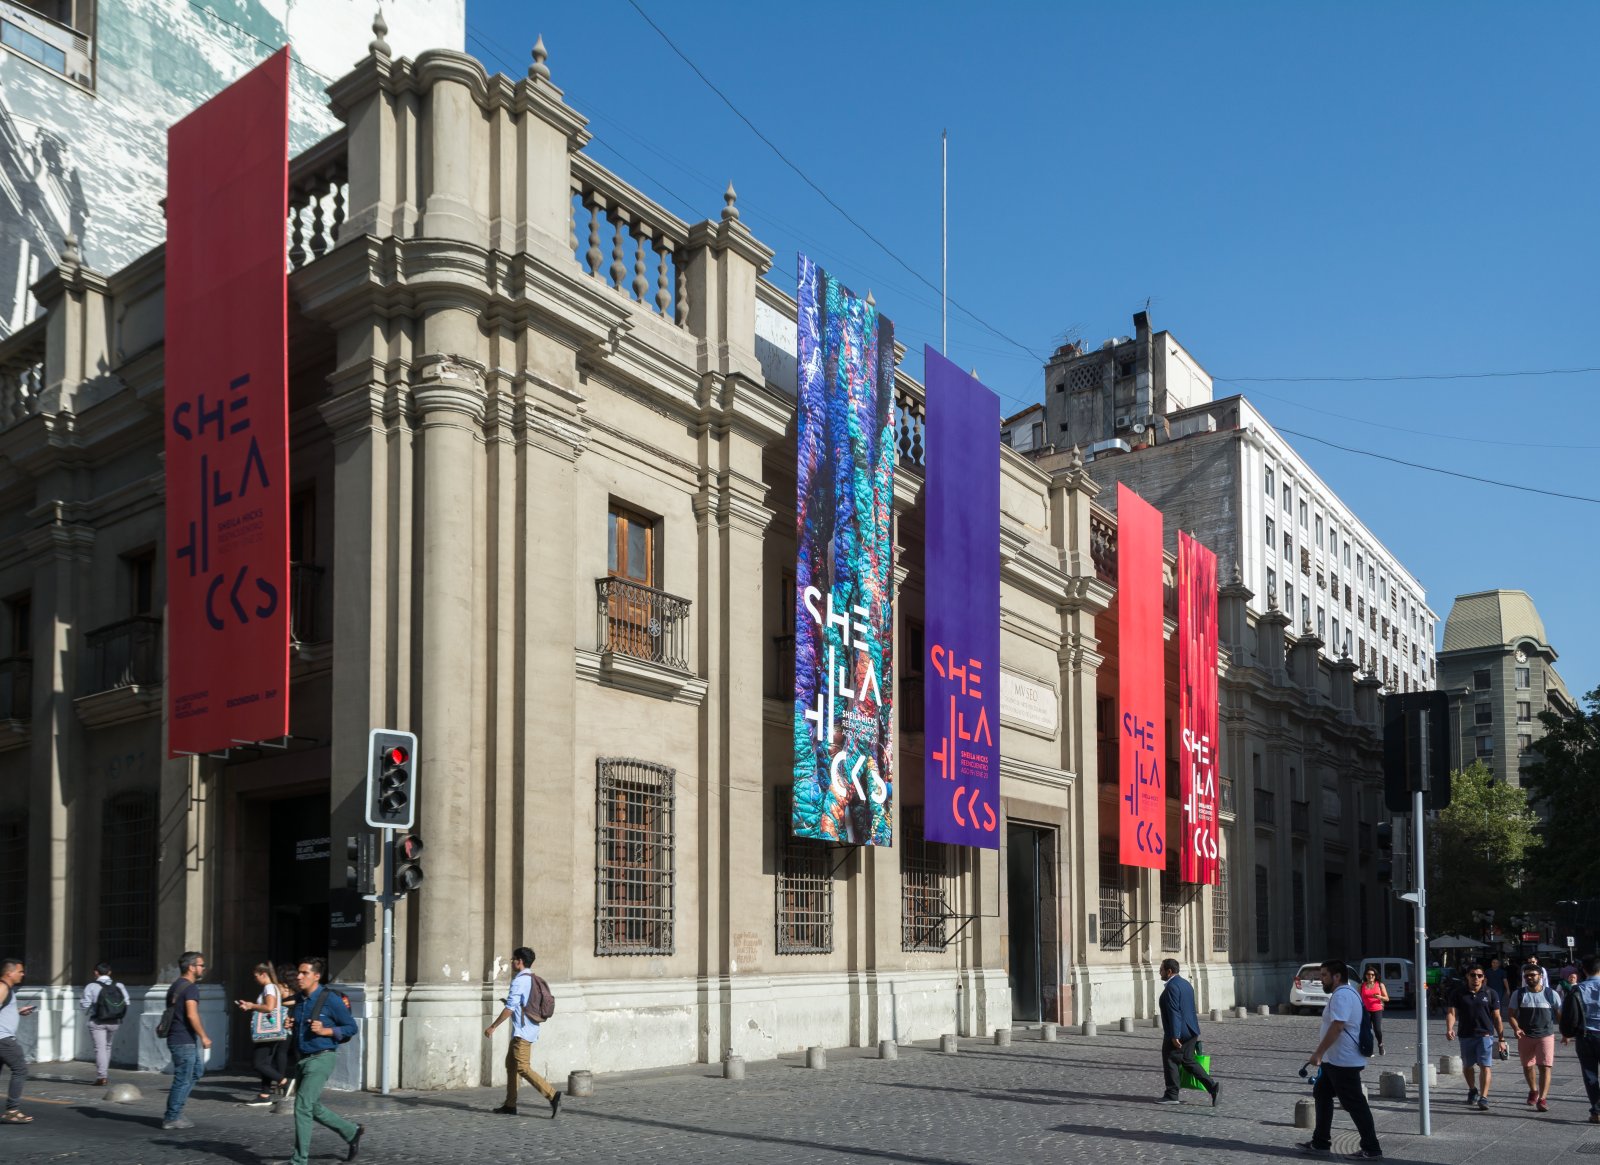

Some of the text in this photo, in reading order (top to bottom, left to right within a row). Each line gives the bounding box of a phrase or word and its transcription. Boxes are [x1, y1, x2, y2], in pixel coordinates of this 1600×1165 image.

[842, 709, 877, 726] SHEILA HICKS
[961, 750, 988, 763] SHEILA HICKS
